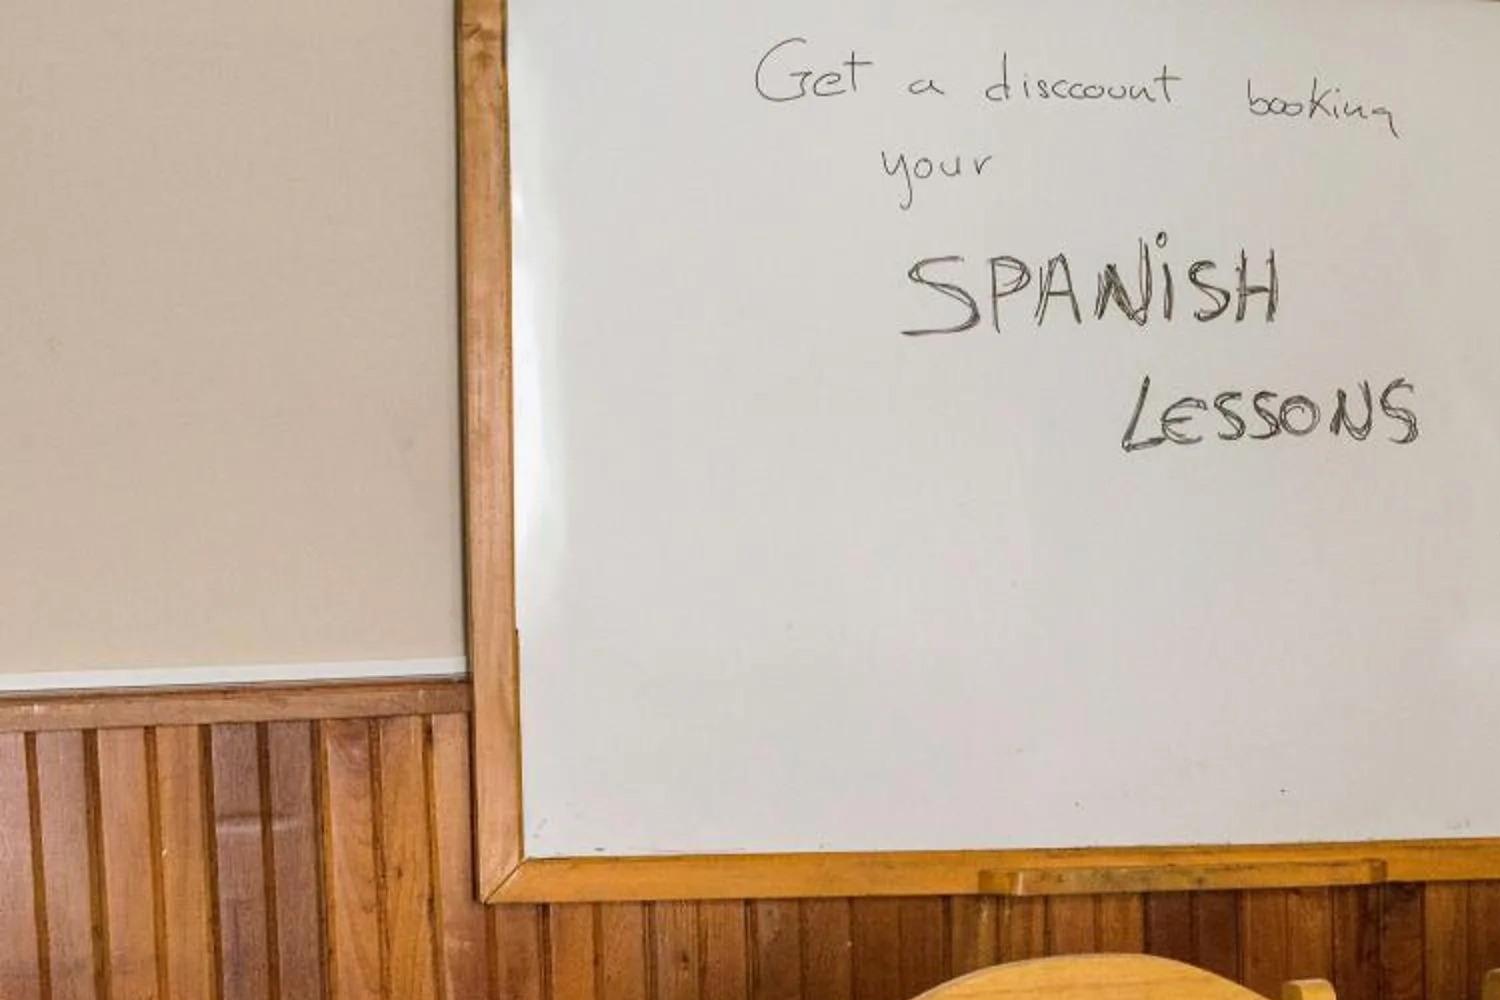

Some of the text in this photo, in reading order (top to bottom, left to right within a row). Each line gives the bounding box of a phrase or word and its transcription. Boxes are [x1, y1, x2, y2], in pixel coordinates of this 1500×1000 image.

[755, 38, 872, 101] Get
[907, 79, 944, 96] a
[1248, 77, 1398, 138] booking
[881, 151, 993, 210] your
[1121, 376, 1419, 452] LESSONS
